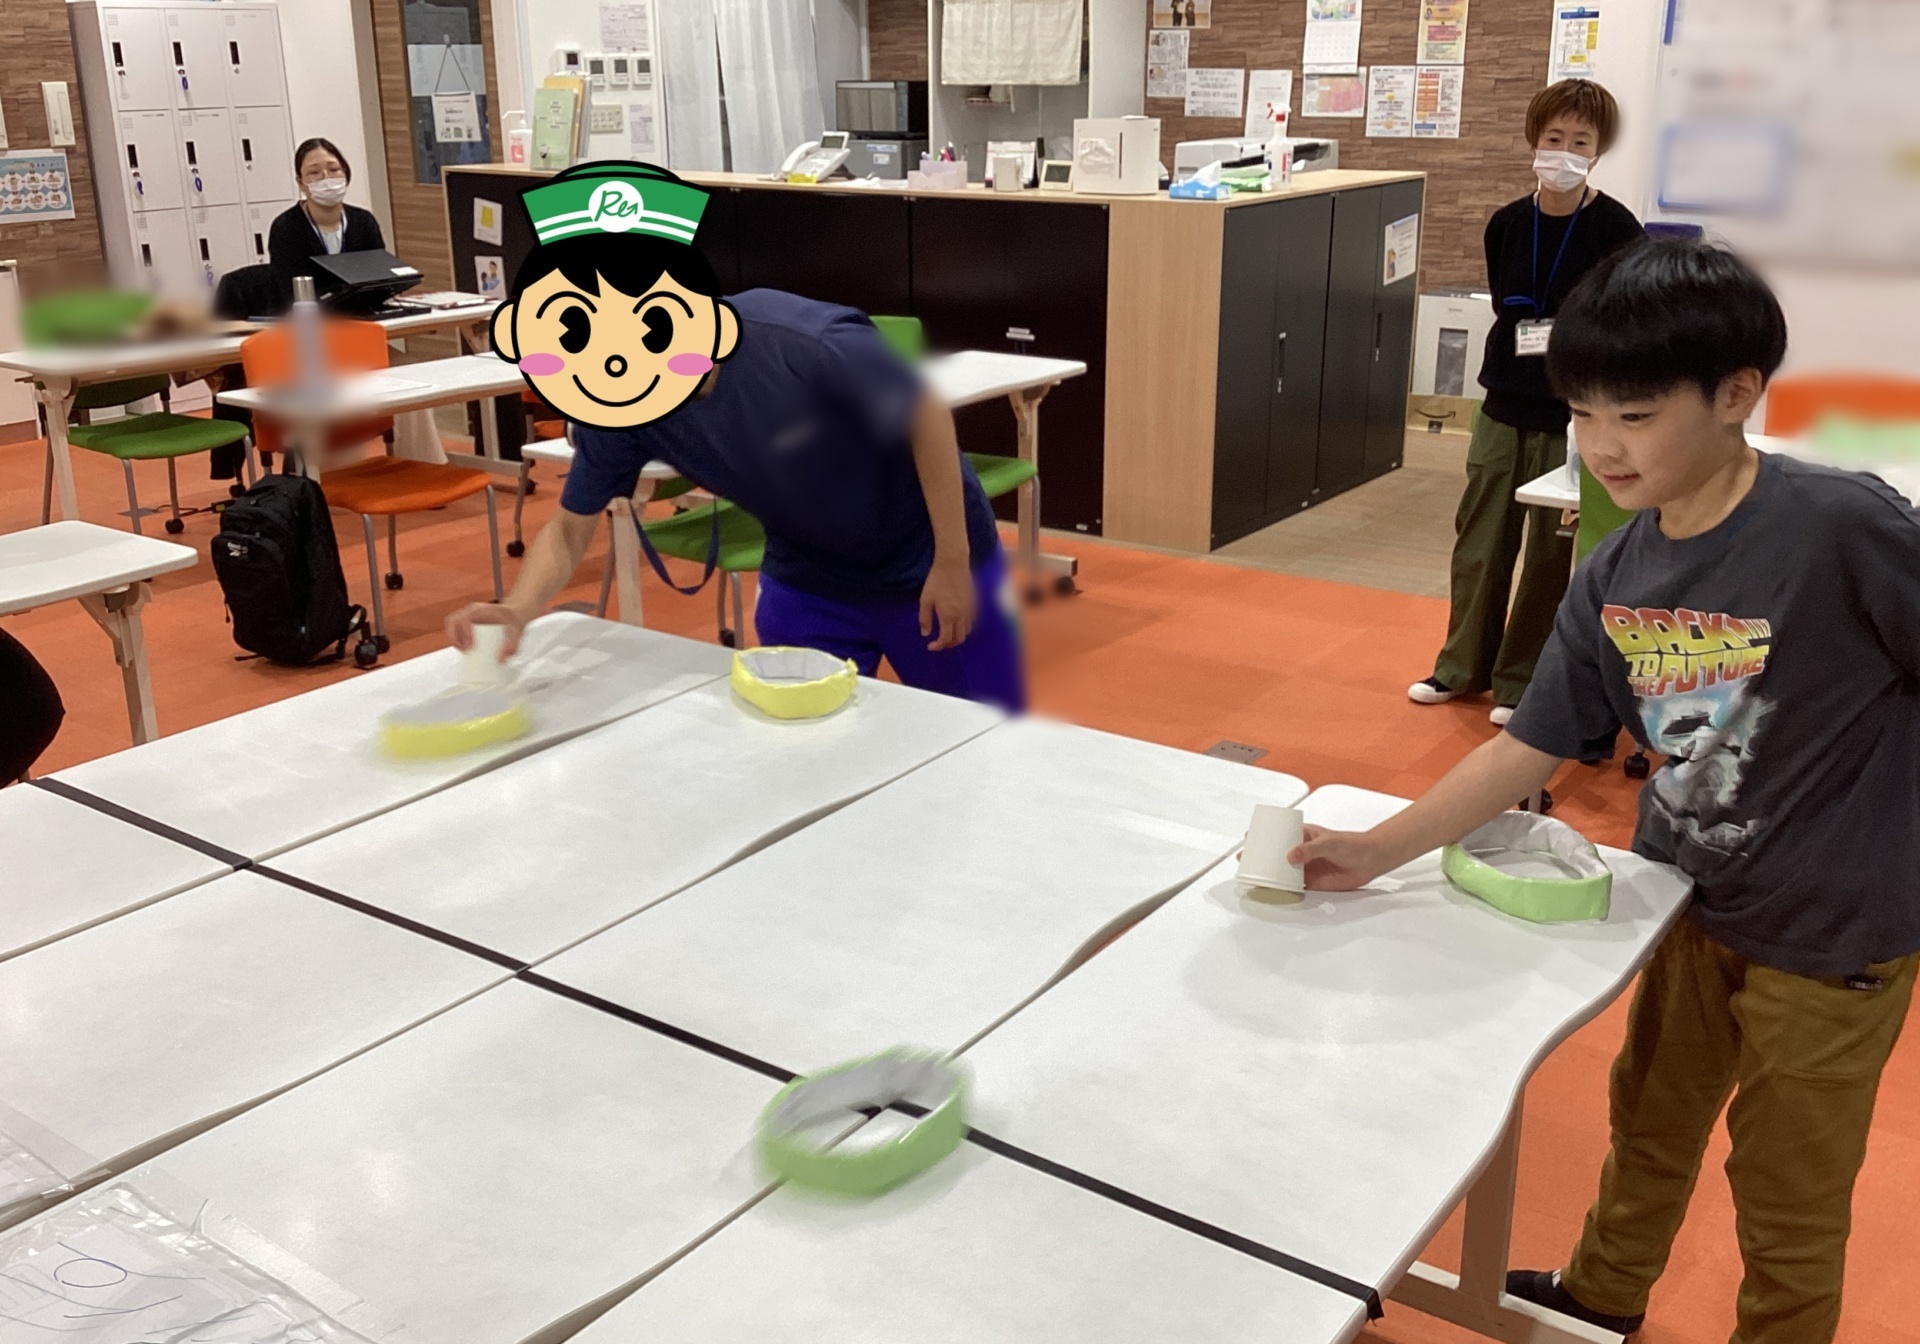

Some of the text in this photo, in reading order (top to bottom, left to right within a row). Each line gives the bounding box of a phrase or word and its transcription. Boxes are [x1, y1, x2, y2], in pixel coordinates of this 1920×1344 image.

[1601, 604, 1771, 657] BACK
[1625, 653, 1660, 677] TO
[1655, 645, 1769, 697] FUTURE
